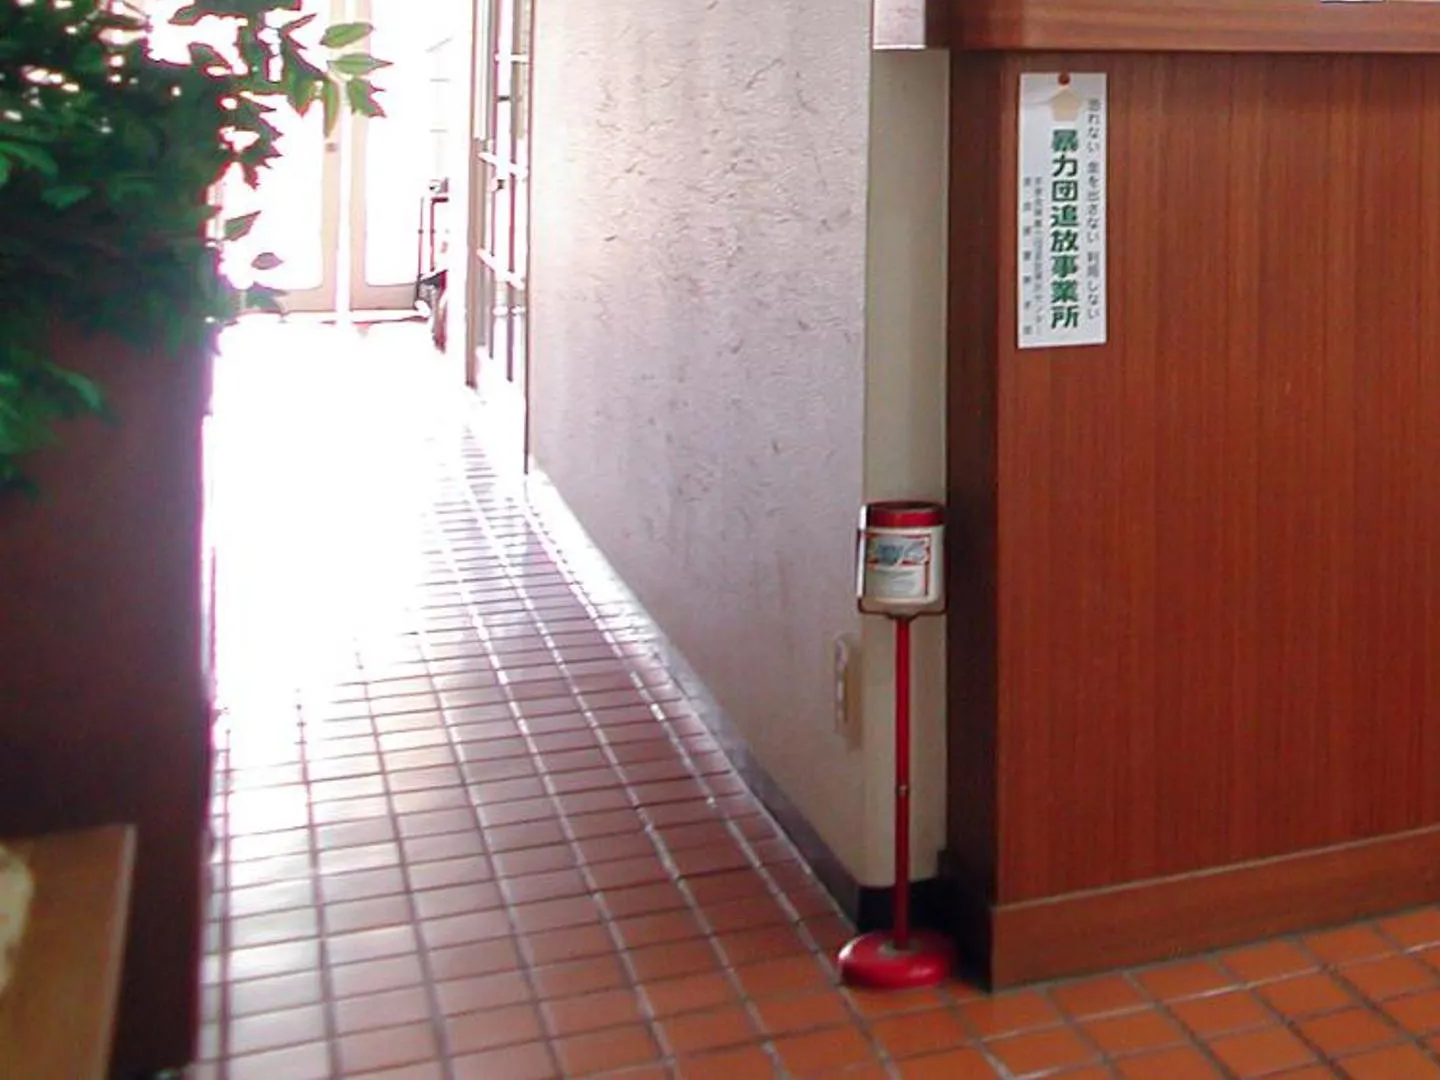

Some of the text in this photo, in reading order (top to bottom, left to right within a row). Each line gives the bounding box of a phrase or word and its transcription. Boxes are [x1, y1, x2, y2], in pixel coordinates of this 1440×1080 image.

[1051, 128, 1079, 330] 暴力団追放事業所
